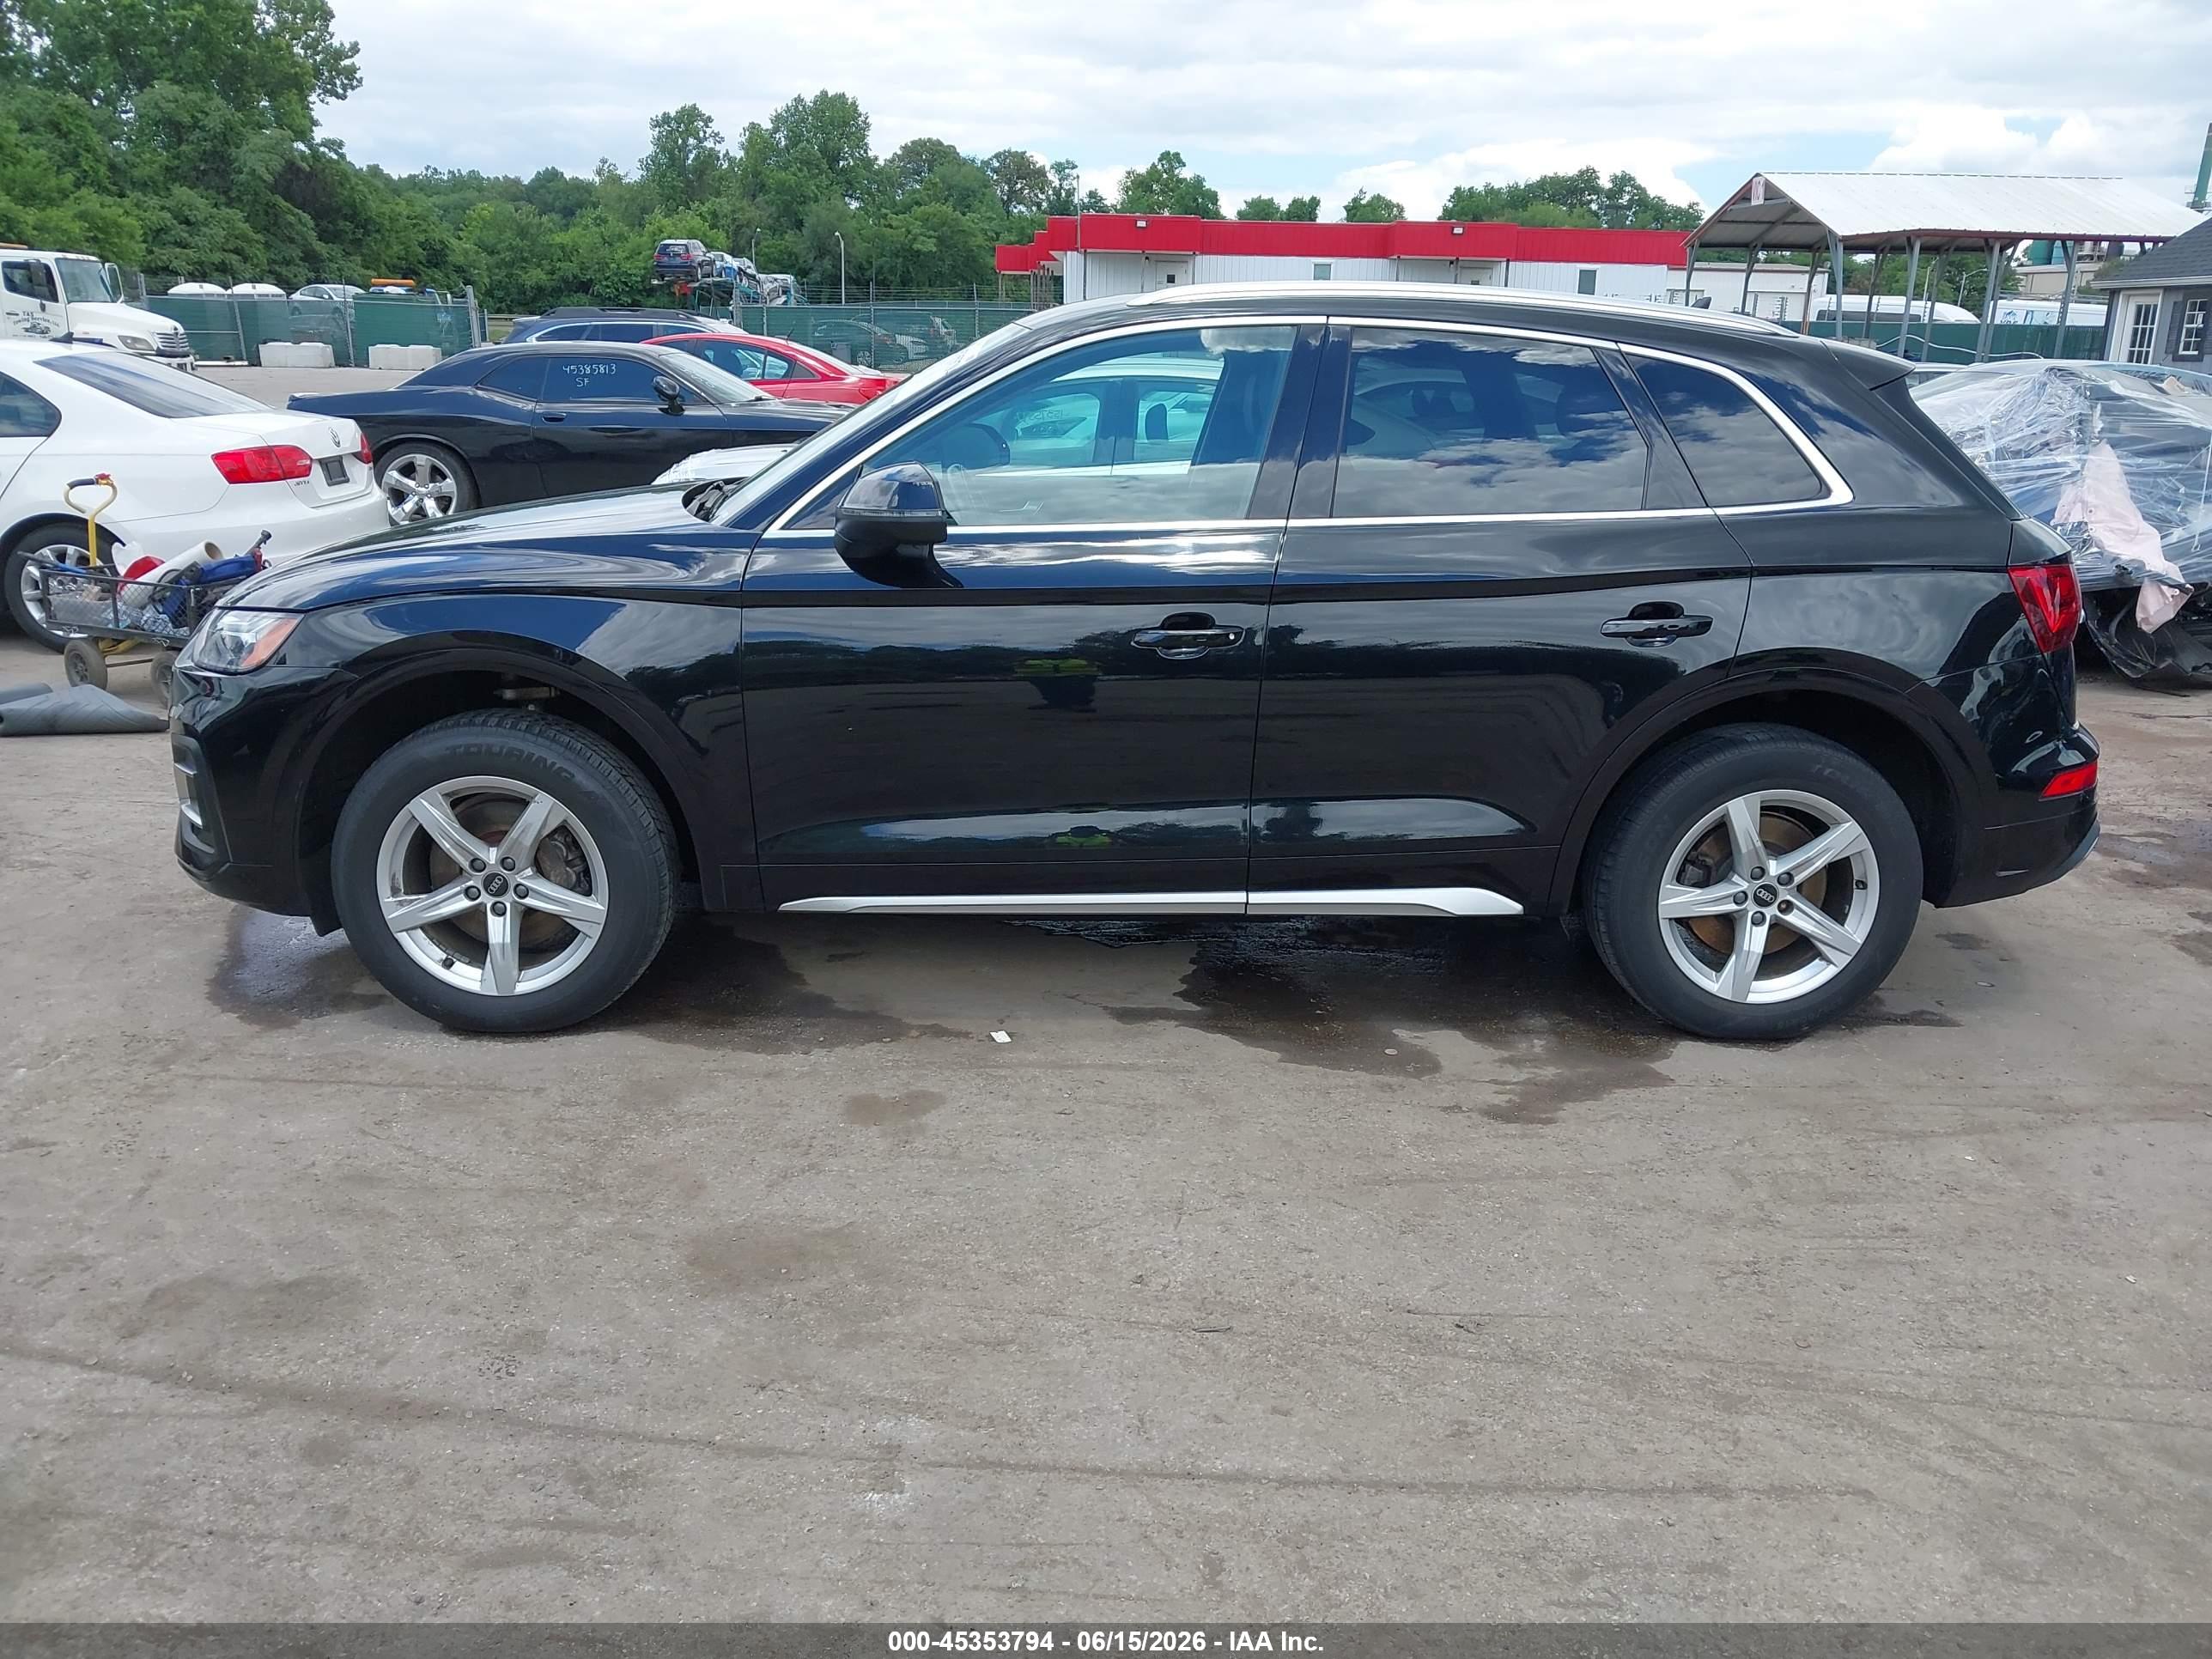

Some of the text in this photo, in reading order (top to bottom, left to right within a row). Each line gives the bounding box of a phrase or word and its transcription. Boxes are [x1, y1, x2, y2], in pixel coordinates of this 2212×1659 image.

[562, 363, 617, 375] 45385813
[575, 377, 591, 387] SF
[445, 743, 576, 780] TOURING
